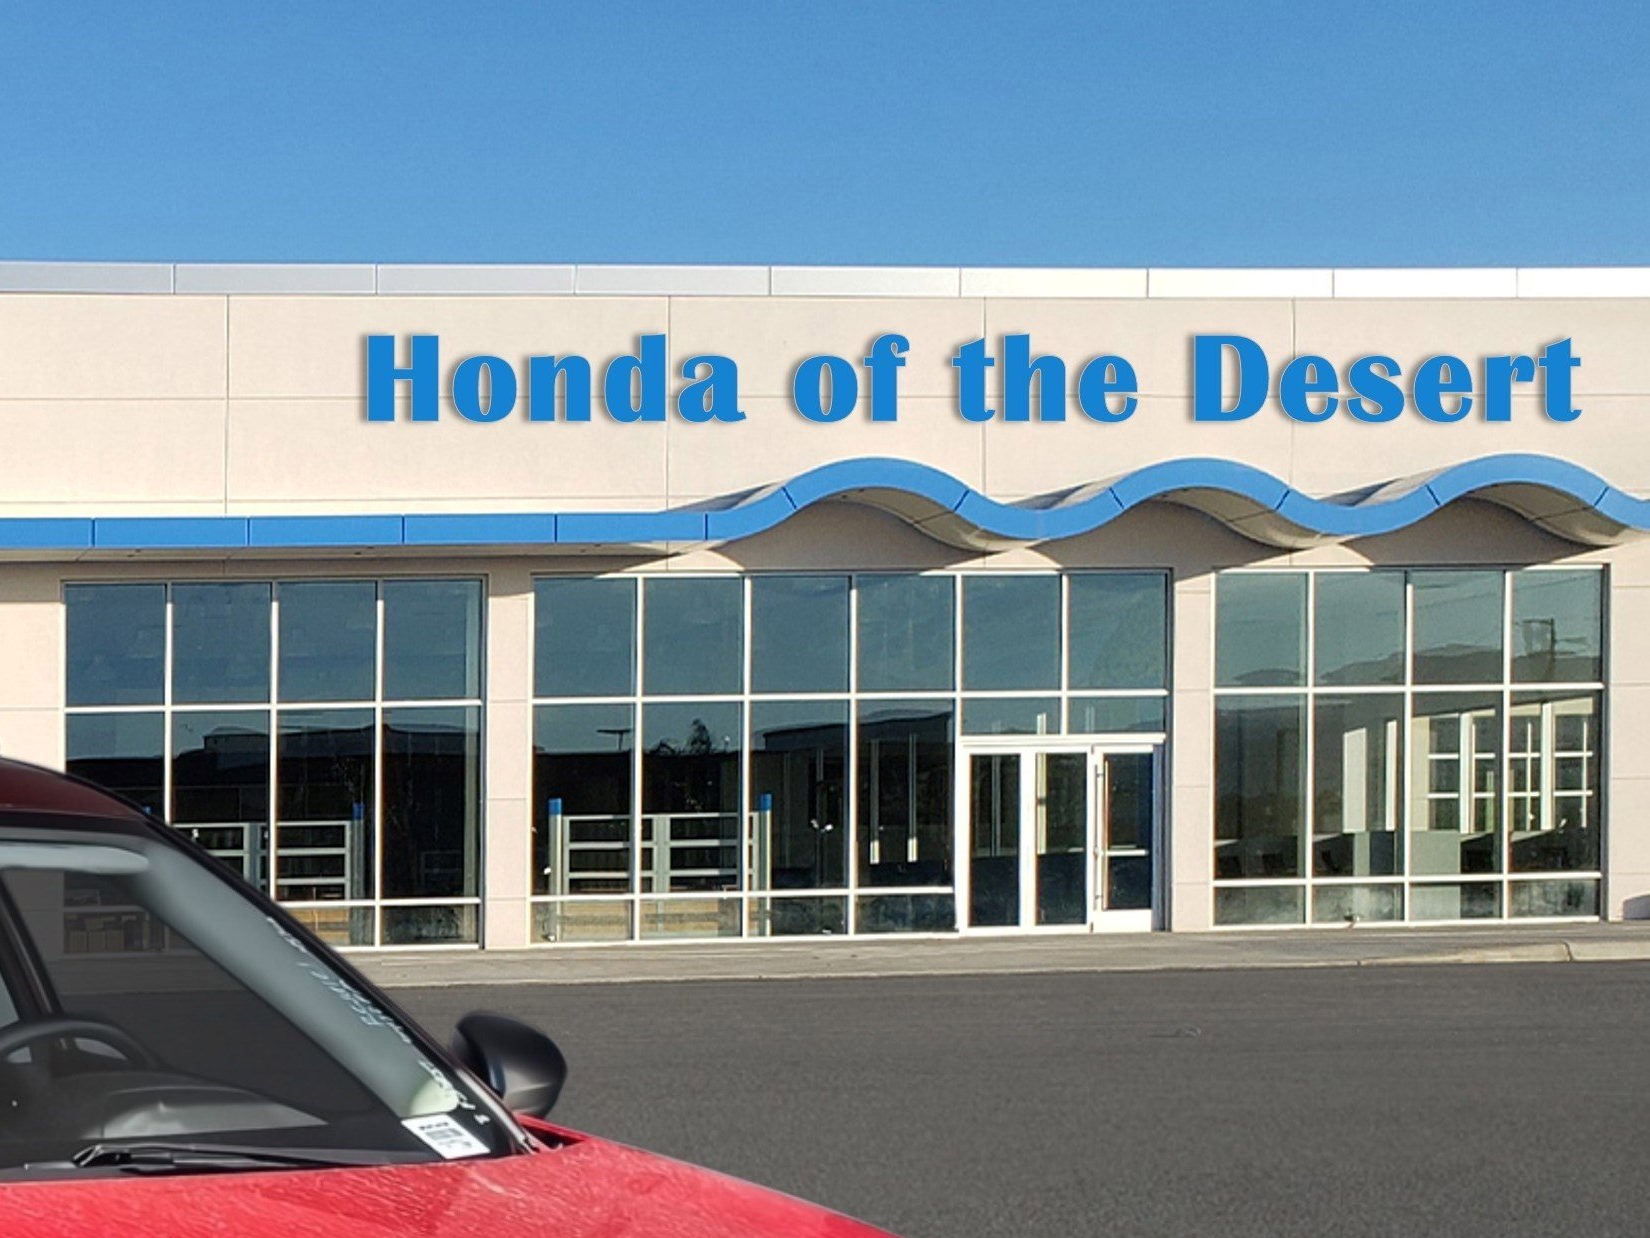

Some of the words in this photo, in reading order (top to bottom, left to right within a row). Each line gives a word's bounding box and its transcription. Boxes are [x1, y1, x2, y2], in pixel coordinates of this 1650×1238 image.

[366, 333, 747, 423] Honda
[792, 333, 910, 423] of
[951, 333, 1139, 423] the
[1193, 334, 1583, 423] Desert
